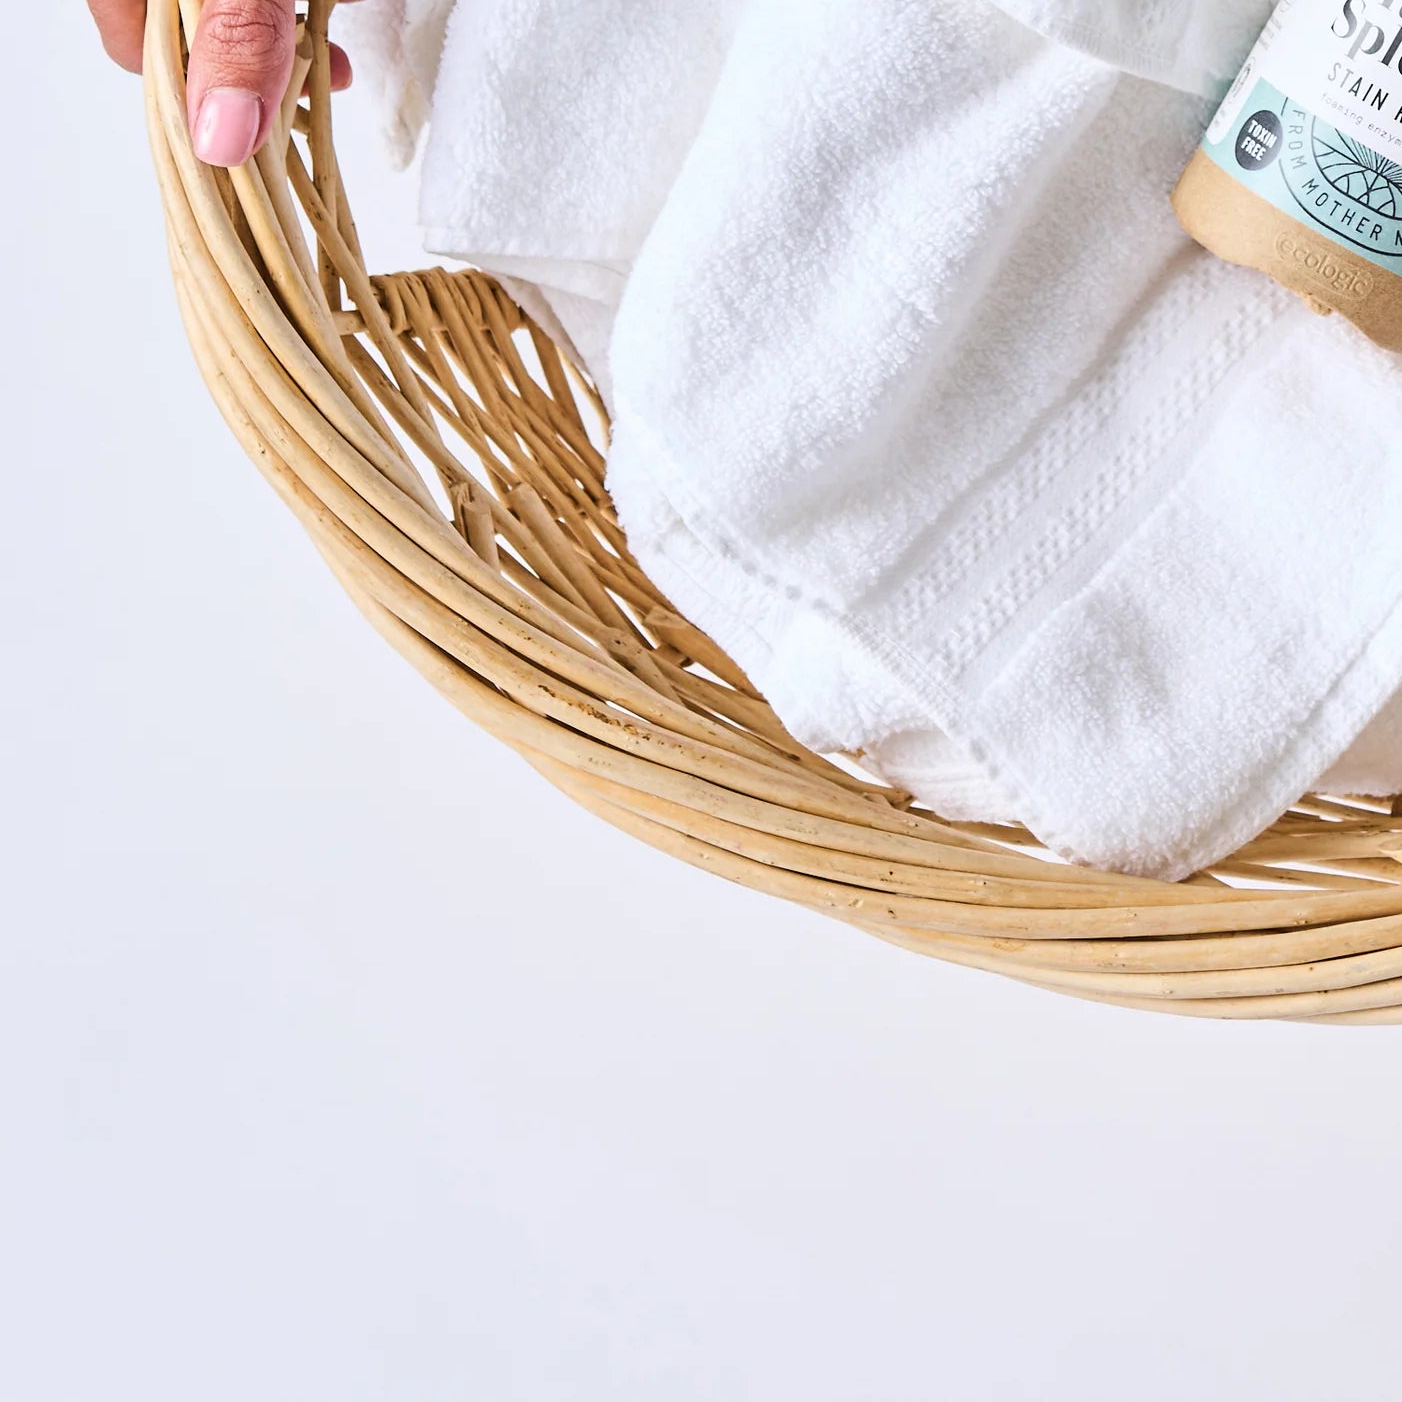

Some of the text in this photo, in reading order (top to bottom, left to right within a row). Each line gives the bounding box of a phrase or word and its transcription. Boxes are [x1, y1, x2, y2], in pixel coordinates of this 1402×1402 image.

[1327, 62, 1389, 111] STAIN
[1321, 92, 1364, 125] foaming
[1240, 136, 1267, 161] FREE
[1247, 119, 1278, 149] TOXIN
[1287, 109, 1308, 170] FROM
[1301, 178, 1383, 241] MOTHER
[1277, 236, 1369, 295] ecologic
